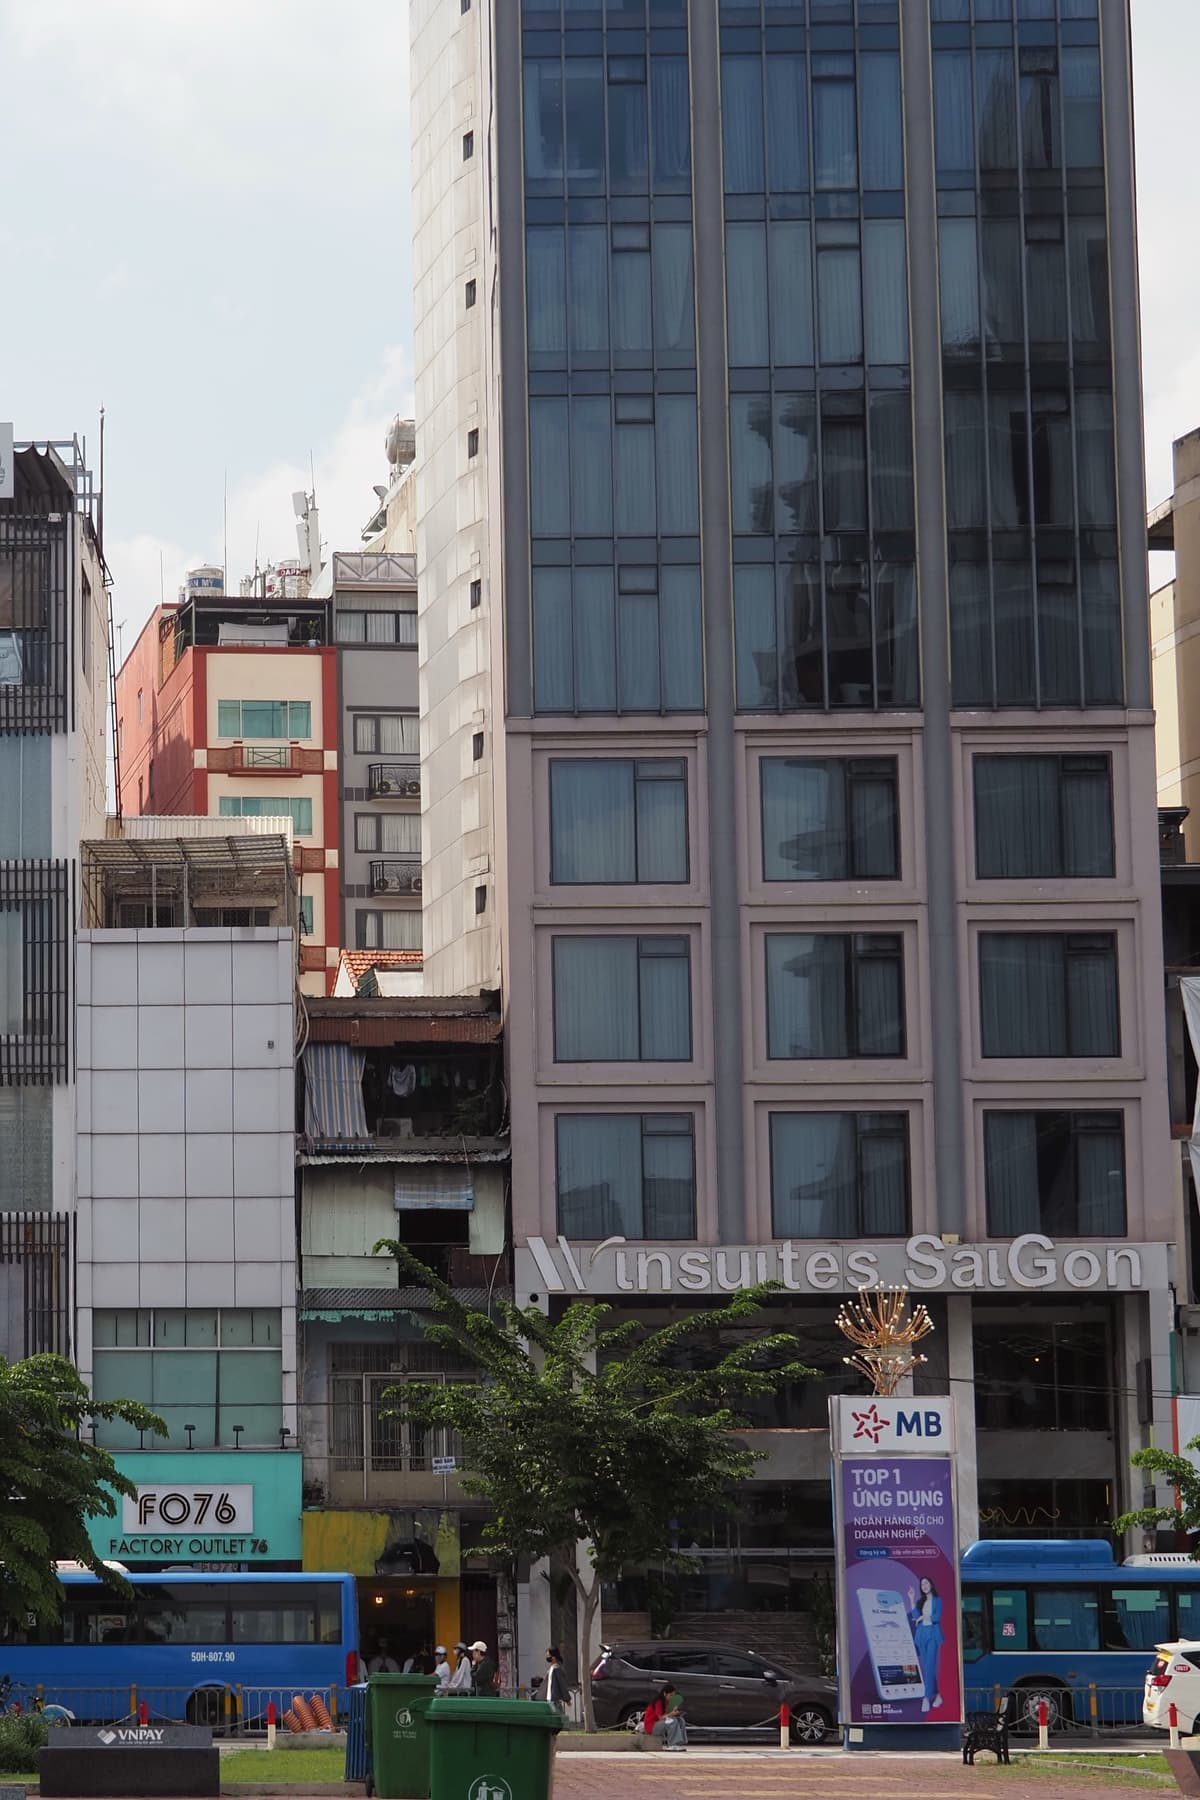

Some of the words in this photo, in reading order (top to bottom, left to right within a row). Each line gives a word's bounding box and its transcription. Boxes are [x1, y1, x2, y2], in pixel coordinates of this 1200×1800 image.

[896, 1411, 942, 1437] MB
[851, 1469, 889, 1485] TOP
[893, 1469, 901, 1485] 1
[853, 1487, 893, 1508] ỨNG
[896, 1490, 944, 1511] DỤNG
[138, 1492, 236, 1525] FO76
[854, 1514, 882, 1526] NGÂN
[884, 1514, 912, 1526] HÀNG
[913, 1513, 926, 1526] SỐ
[926, 1515, 944, 1525] CHO
[854, 1529, 890, 1540] DOANH
[891, 1528, 926, 1542] NGHIỆP
[109, 1538, 184, 1554] FACTORY
[188, 1538, 247, 1554] OUTLET
[250, 1538, 269, 1554] 76
[118, 1728, 165, 1741] VNPAY
